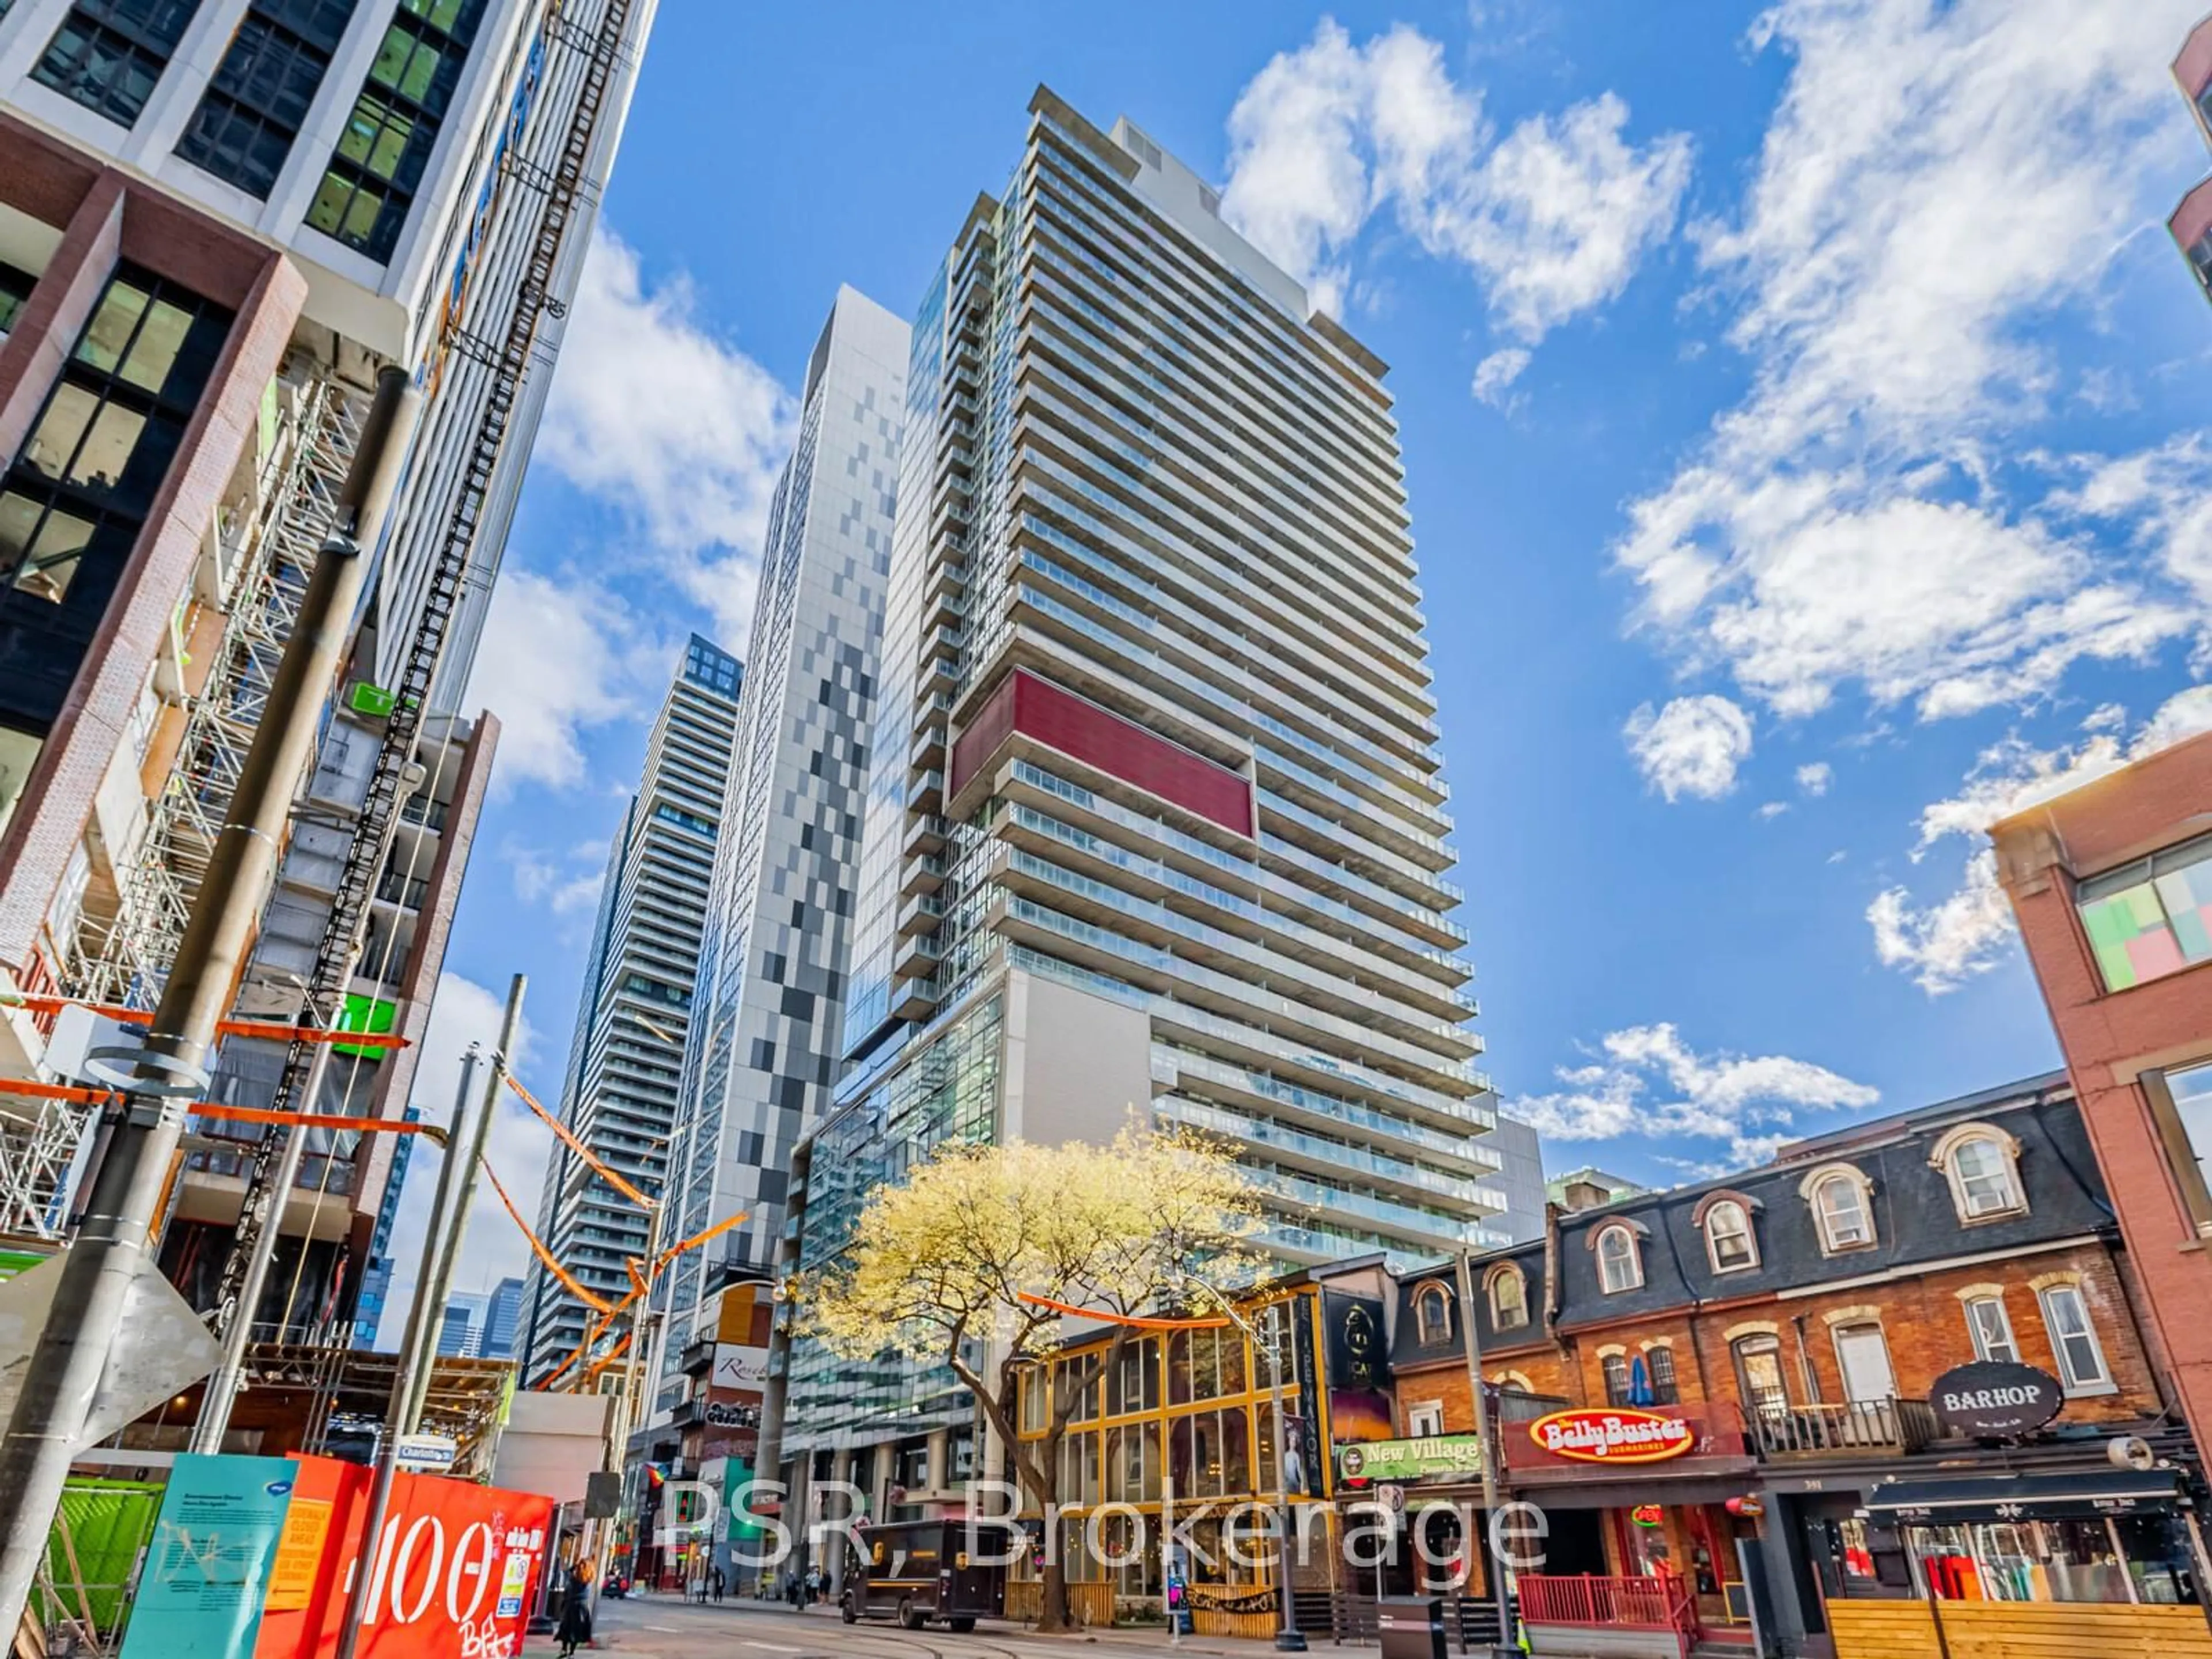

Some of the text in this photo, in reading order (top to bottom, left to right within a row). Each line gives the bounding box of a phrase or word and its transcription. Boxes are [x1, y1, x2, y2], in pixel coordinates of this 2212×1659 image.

[1943, 1385, 2041, 1411] BARHOP
[1367, 1439, 1479, 1465] New Village
